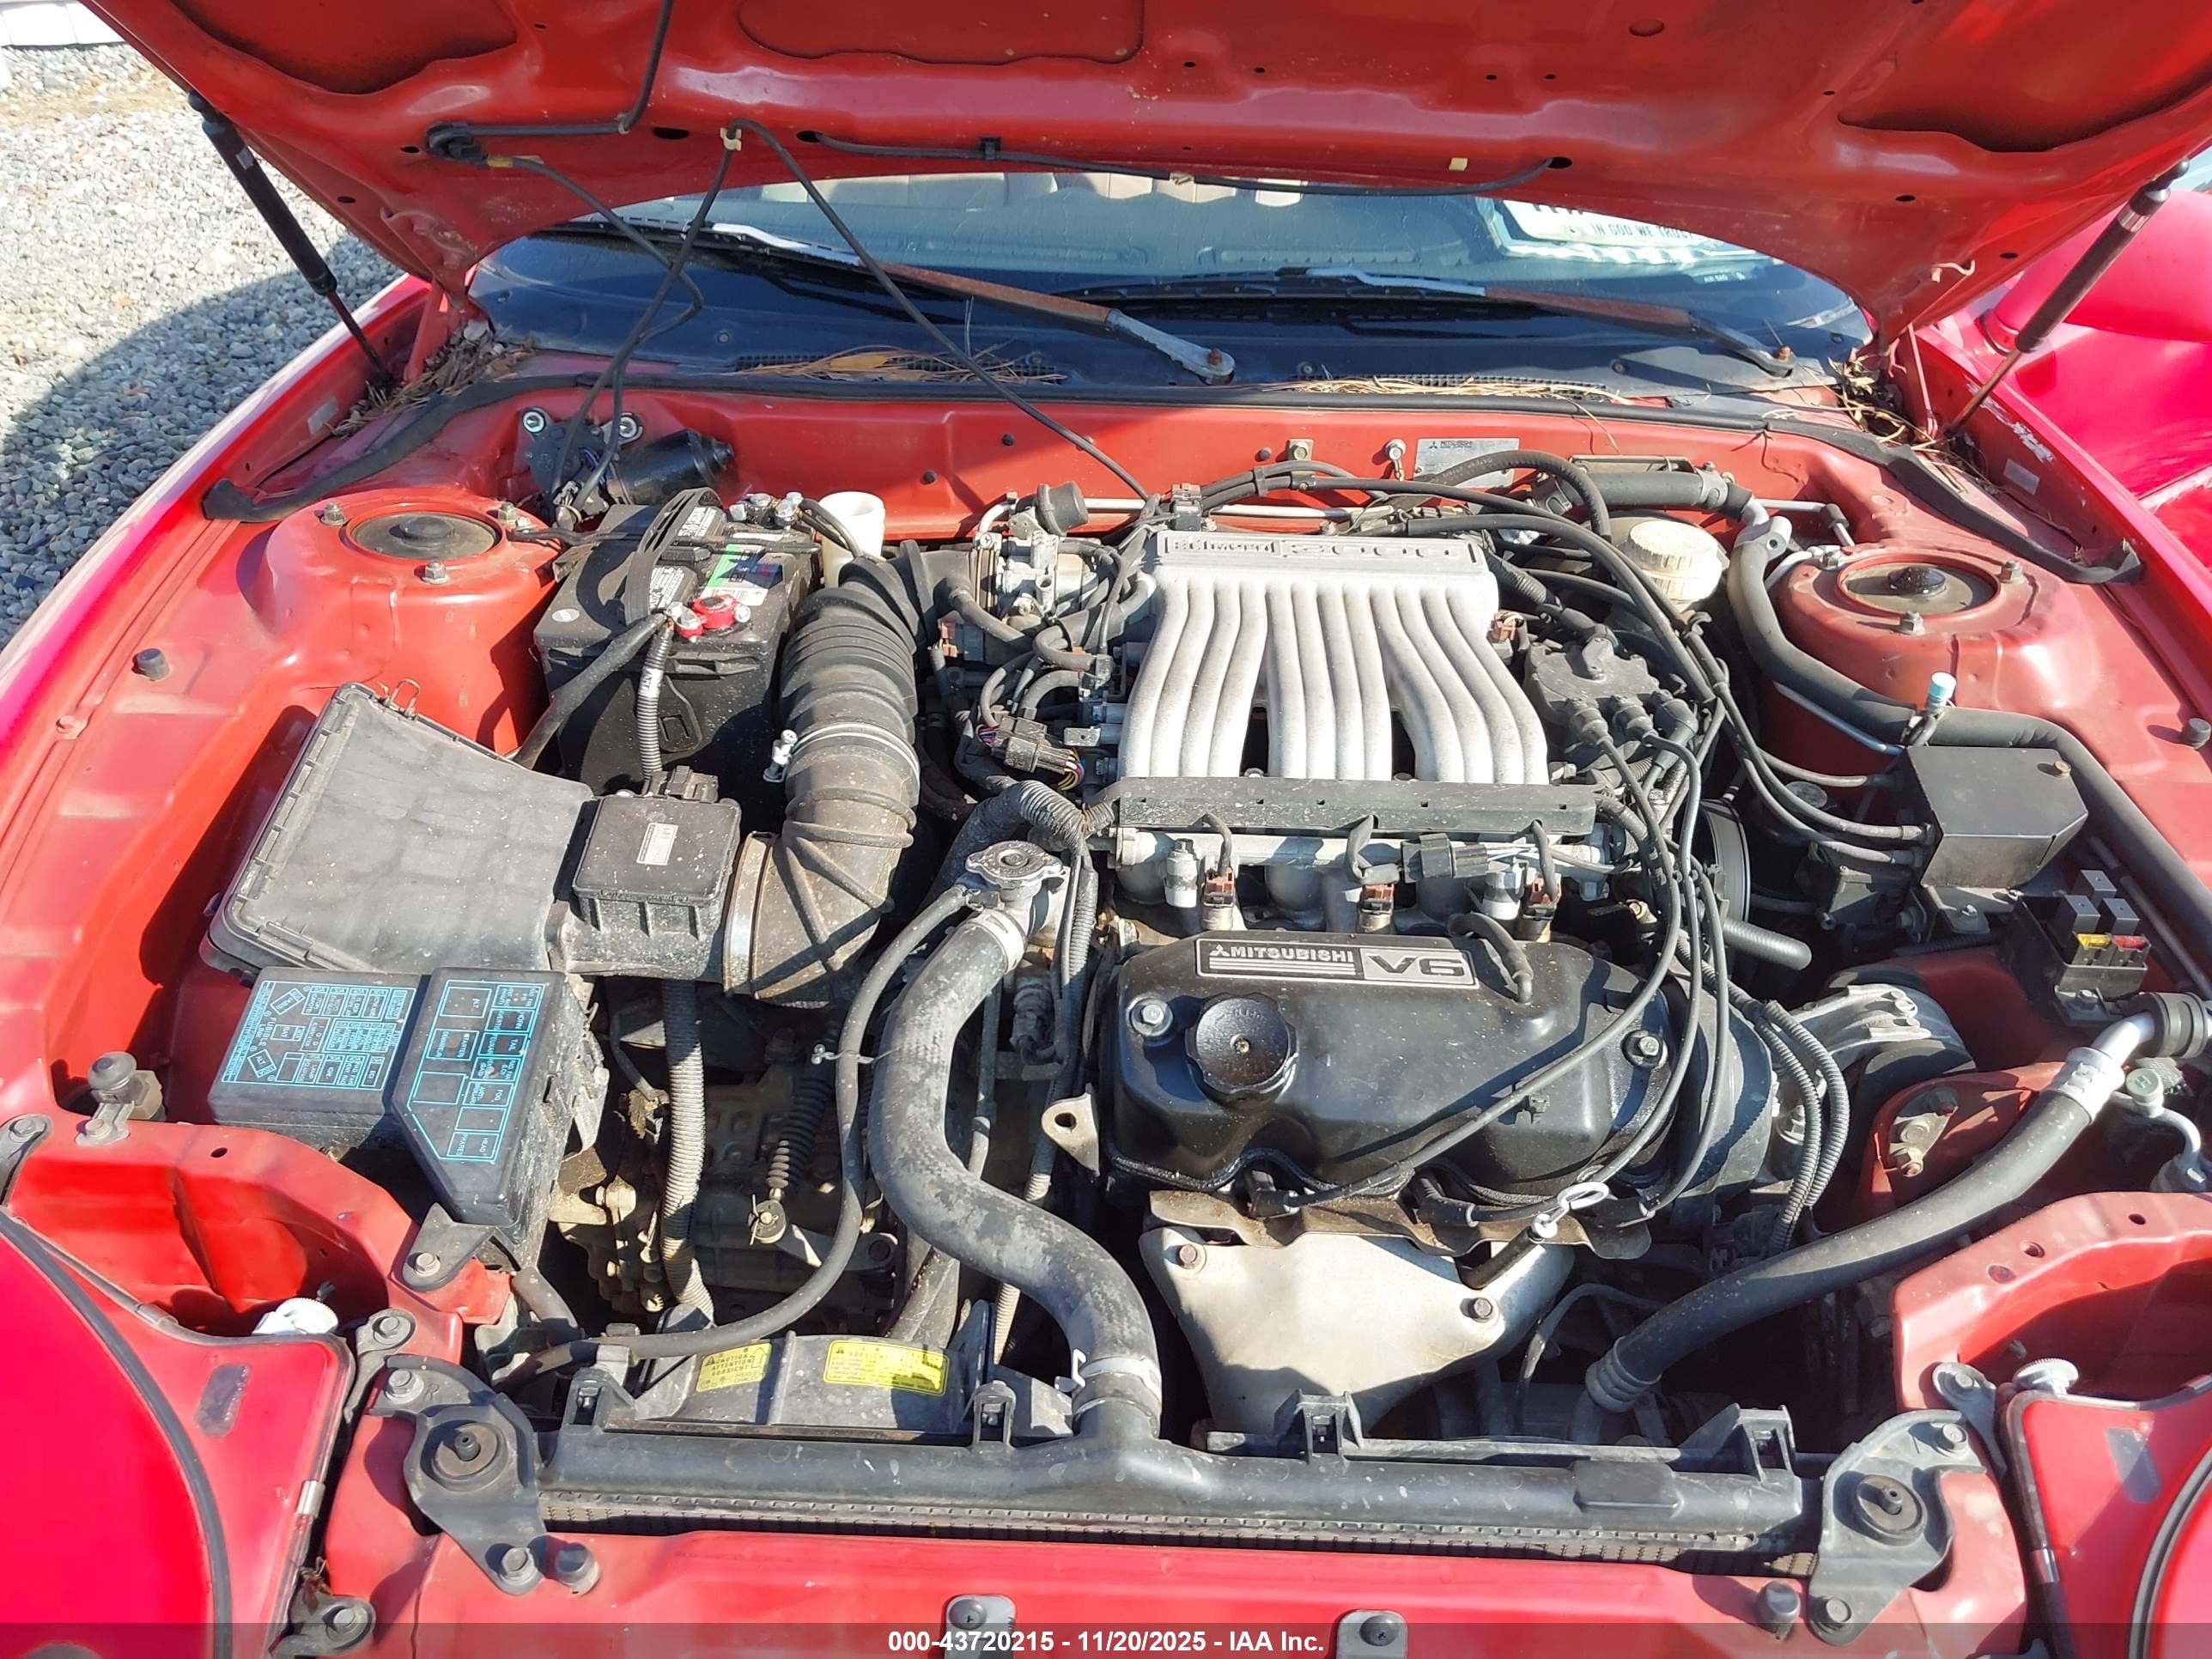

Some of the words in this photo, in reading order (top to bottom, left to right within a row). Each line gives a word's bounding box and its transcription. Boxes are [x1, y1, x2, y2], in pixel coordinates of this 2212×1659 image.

[1591, 224, 1605, 234] IN
[1608, 224, 1632, 235] GOD
[1635, 225, 1654, 236] WE
[1230, 945, 1354, 963] MITSUBISHI
[1365, 955, 1466, 978] V6
